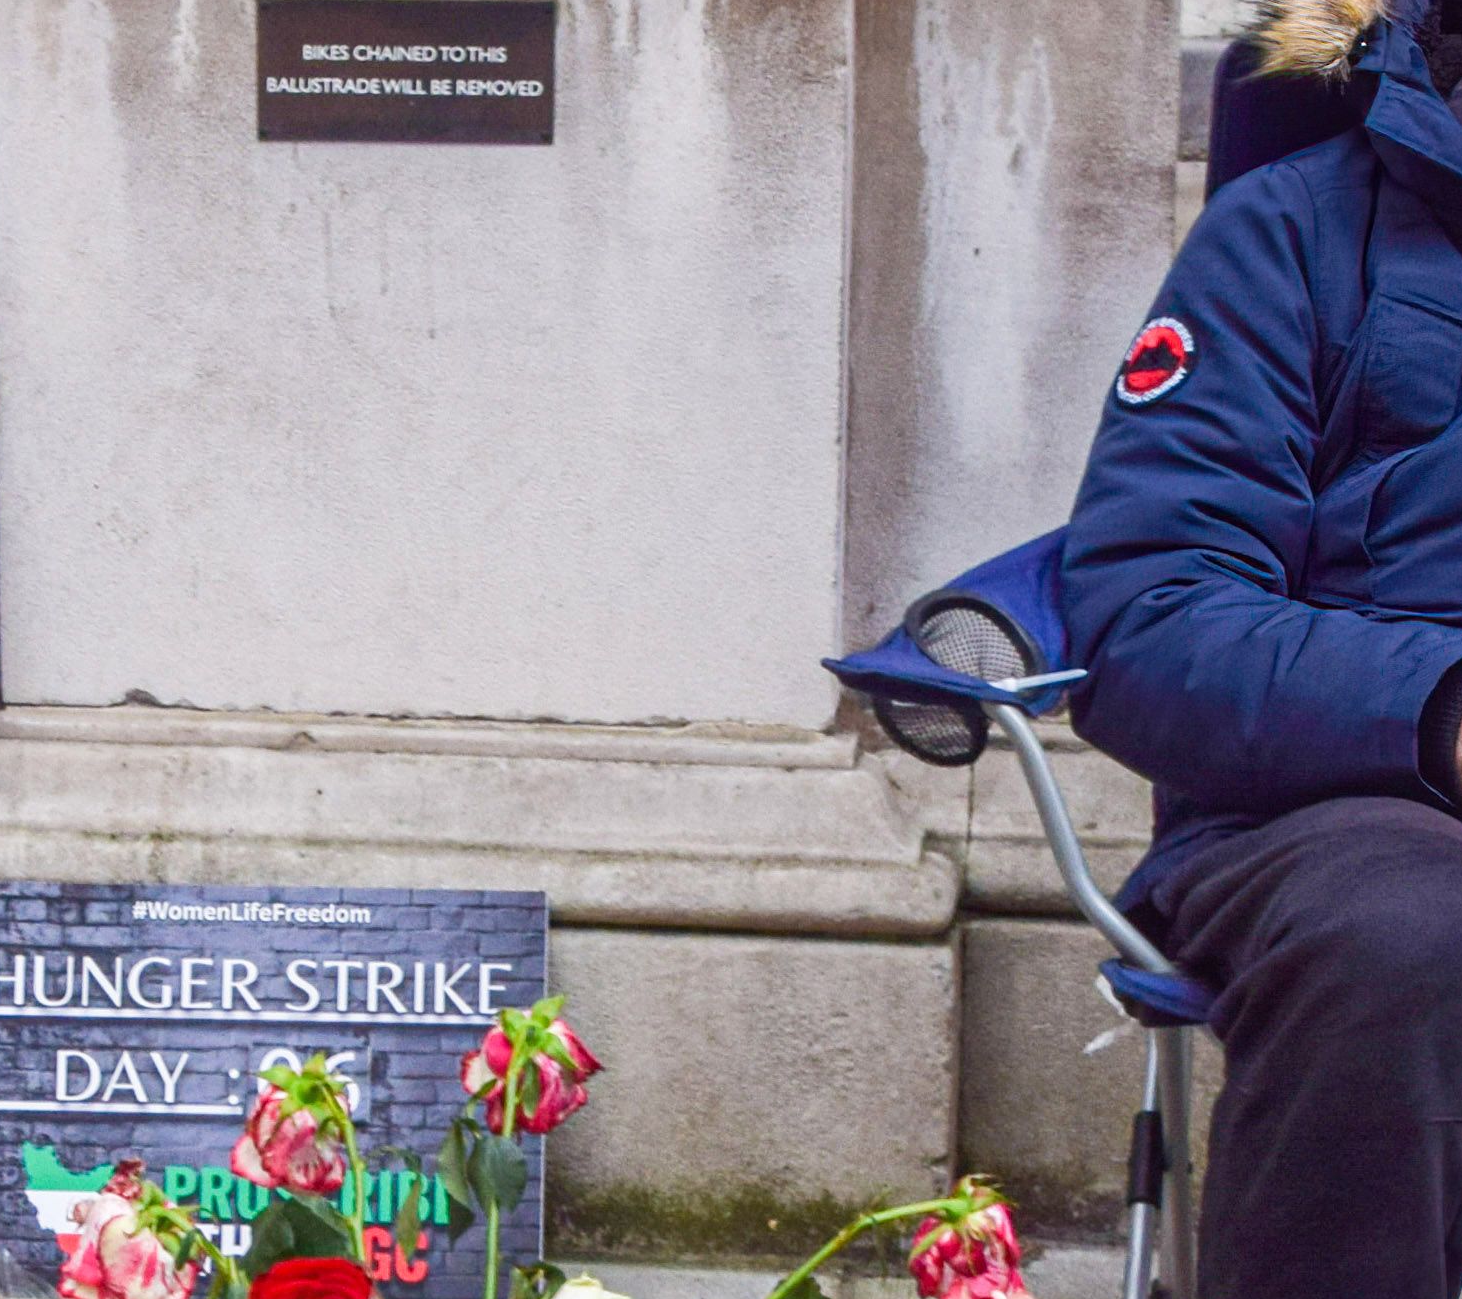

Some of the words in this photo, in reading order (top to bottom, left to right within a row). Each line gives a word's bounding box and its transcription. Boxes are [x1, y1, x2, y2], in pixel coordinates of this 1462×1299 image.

[302, 44, 349, 62] BIKES
[352, 45, 437, 63] CHAINED
[438, 47, 467, 62] TO
[468, 47, 508, 63] THIS
[266, 77, 381, 95] BALUSTRADE
[382, 79, 427, 95] WILL
[430, 79, 453, 95] BE
[455, 80, 544, 97] REMOVED
[132, 901, 371, 926] #WomenLifeFreedom
[285, 958, 513, 1016] STRIKE
[55, 1049, 189, 1103] DAY
